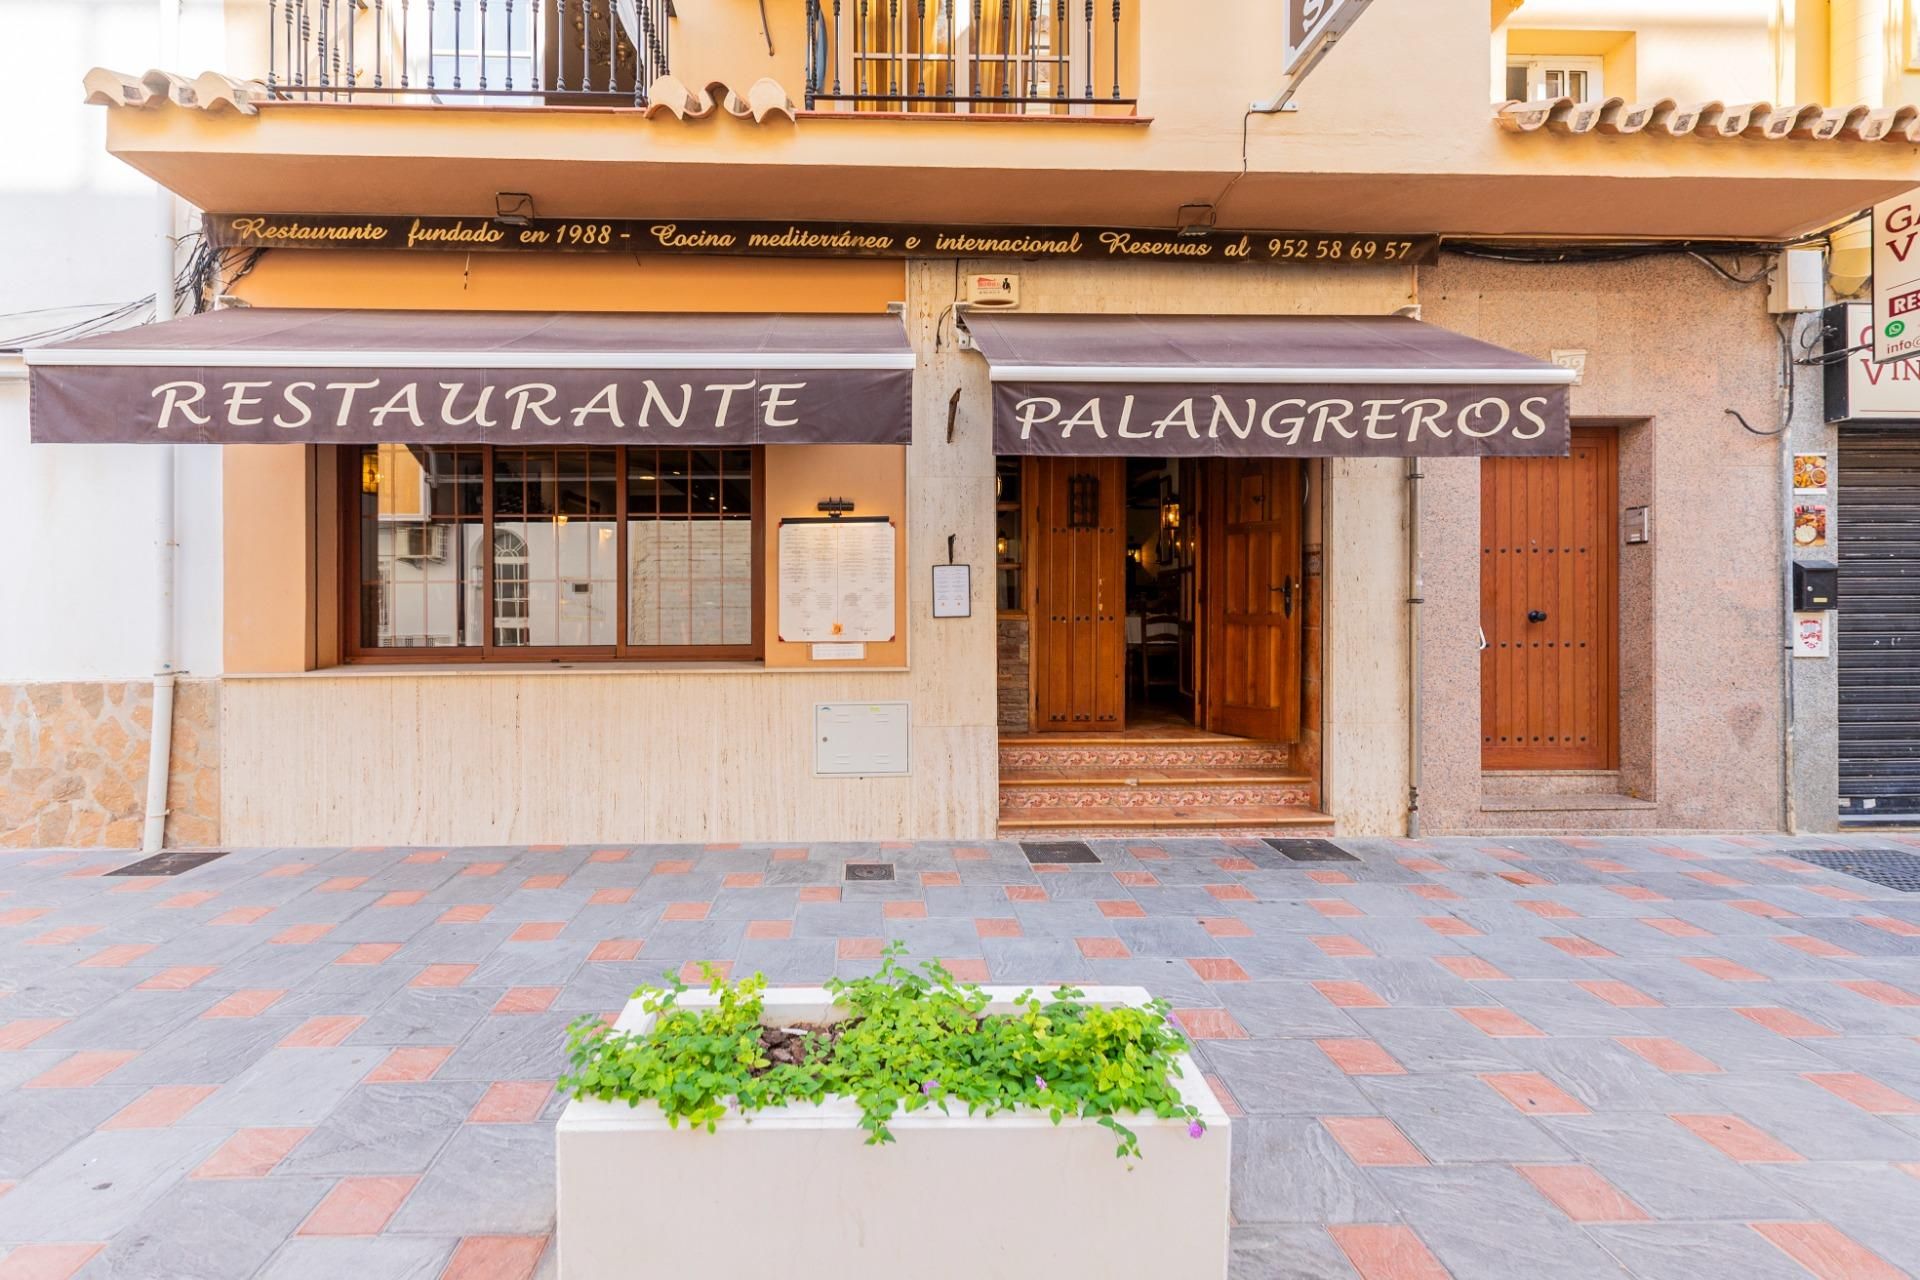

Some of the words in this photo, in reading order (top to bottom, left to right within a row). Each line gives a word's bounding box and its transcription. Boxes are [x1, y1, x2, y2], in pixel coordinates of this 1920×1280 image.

[231, 217, 389, 242] Restaurante
[408, 216, 504, 248] fundado
[519, 230, 550, 244] en
[556, 224, 612, 245] 1988
[650, 224, 736, 248] Cocina
[748, 226, 894, 249] mediterránea
[905, 236, 921, 250] e
[935, 232, 1083, 254] internacional
[1099, 232, 1212, 256] Reservas
[1224, 235, 1251, 257] al
[1268, 238, 1308, 258] 952
[1316, 240, 1342, 259] 58
[1350, 241, 1377, 260] 69
[1384, 242, 1412, 260] 57
[152, 379, 808, 430] RESTAURANTE
[1015, 394, 1548, 446] PALANGREROS
